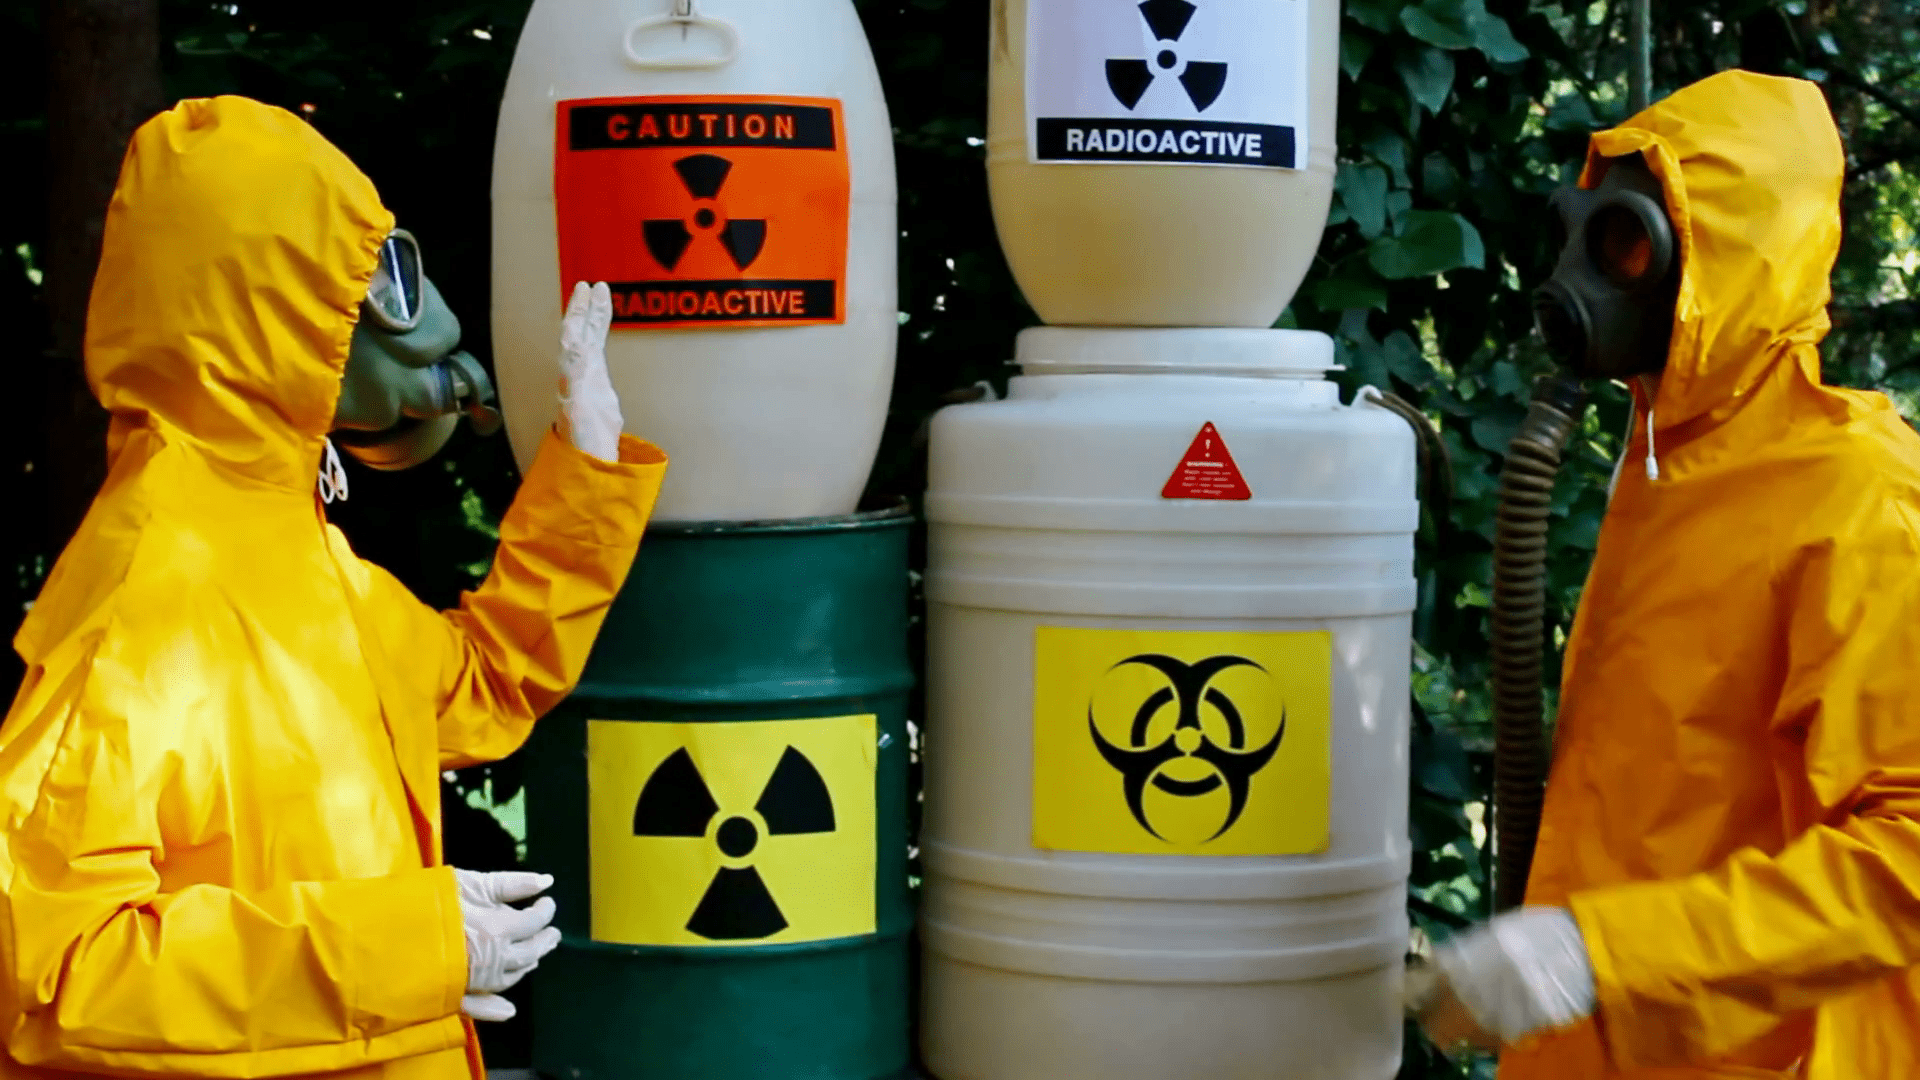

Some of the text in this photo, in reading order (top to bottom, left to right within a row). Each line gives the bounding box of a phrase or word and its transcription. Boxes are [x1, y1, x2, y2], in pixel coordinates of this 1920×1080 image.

[607, 114, 797, 140] CAUTION
[1066, 128, 1262, 157] RADIOACTIVE
[612, 290, 805, 316] RADIOACTIVE
